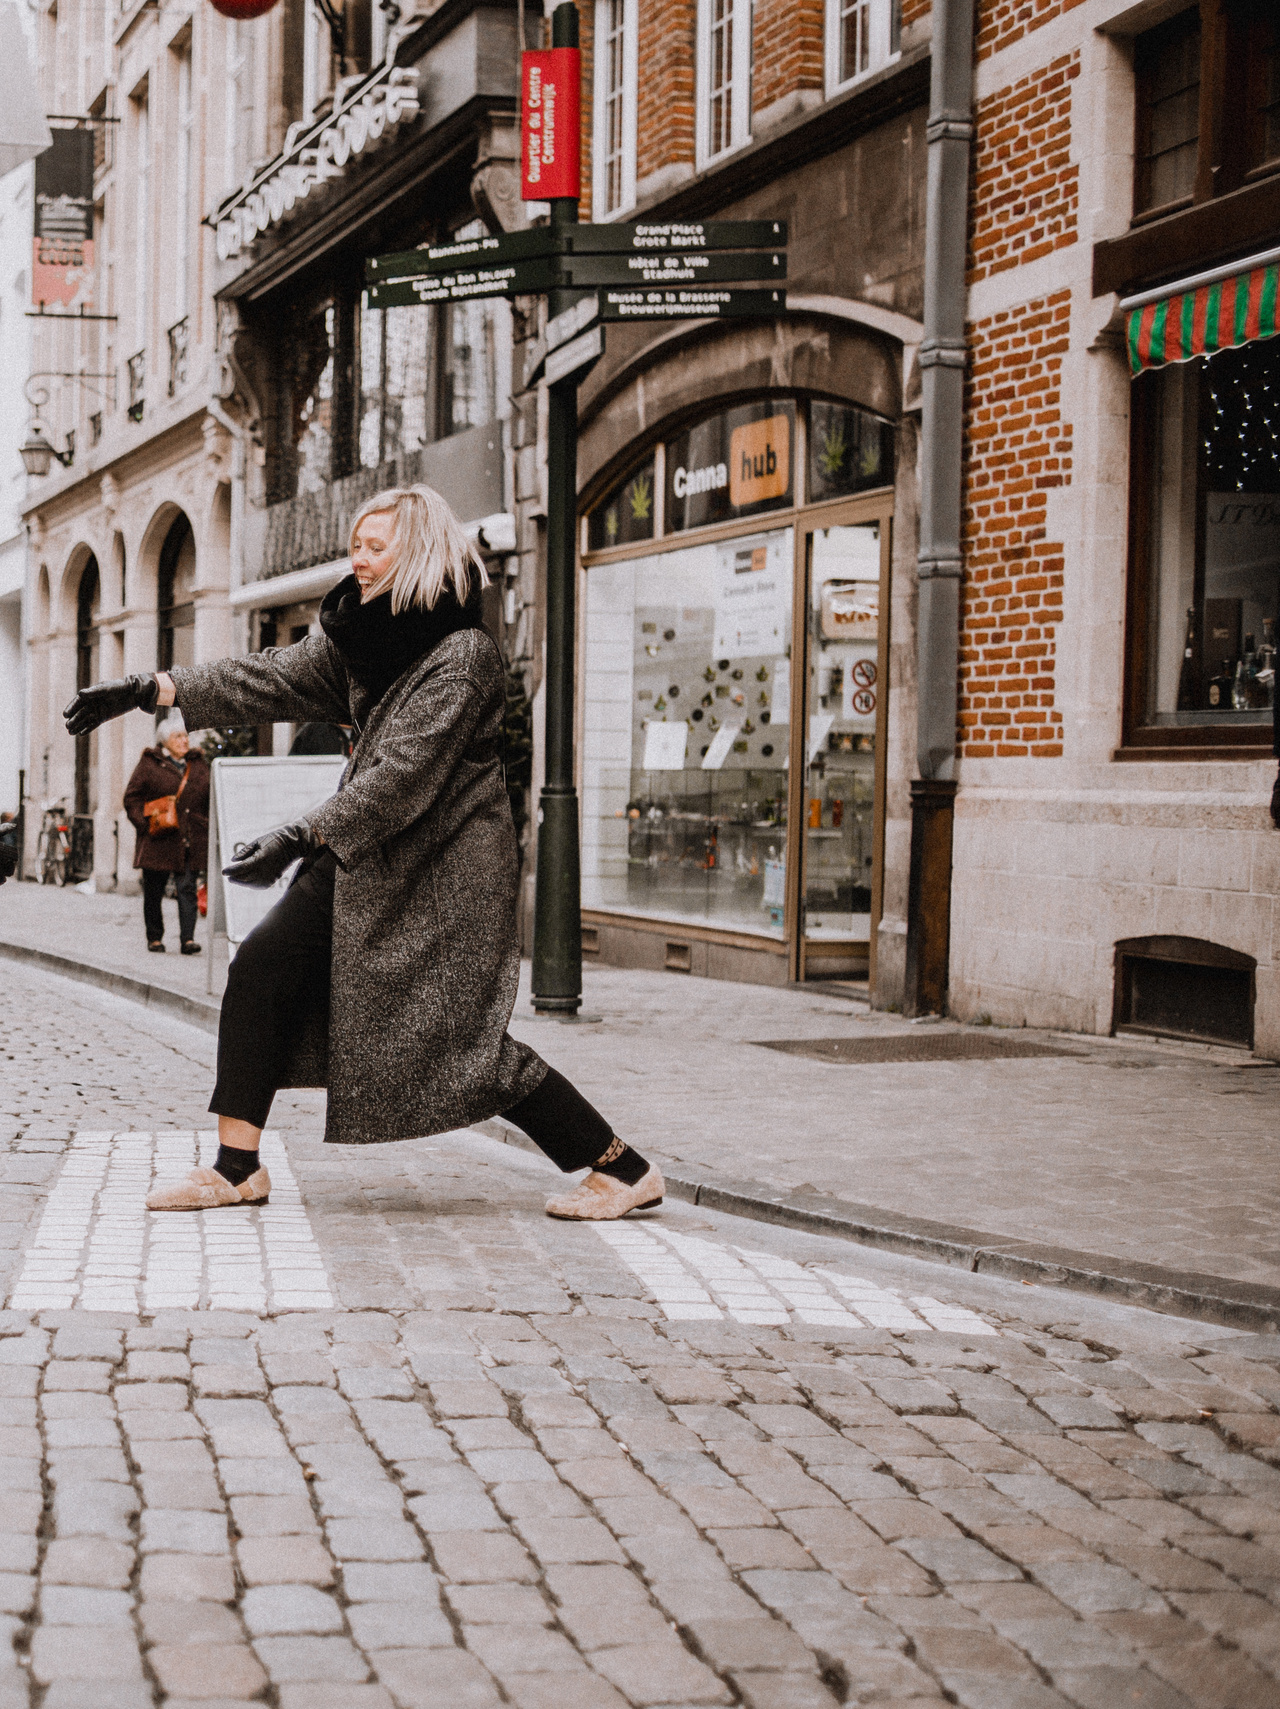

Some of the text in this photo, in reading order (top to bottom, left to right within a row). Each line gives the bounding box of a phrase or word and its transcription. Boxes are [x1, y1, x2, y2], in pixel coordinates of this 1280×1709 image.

[527, 66, 542, 183] Quartier du Centre
[542, 83, 557, 164] Centrumwijk
[633, 235, 706, 247] Grote Markt
[628, 256, 710, 269] Hôtel de Ville
[442, 276, 456, 287] du
[457, 273, 477, 285] Bon
[642, 268, 695, 280] Stadhuis
[420, 288, 450, 301] Goede
[607, 291, 732, 303] Musée de la Brasserie
[673, 442, 778, 499] Canna hub
